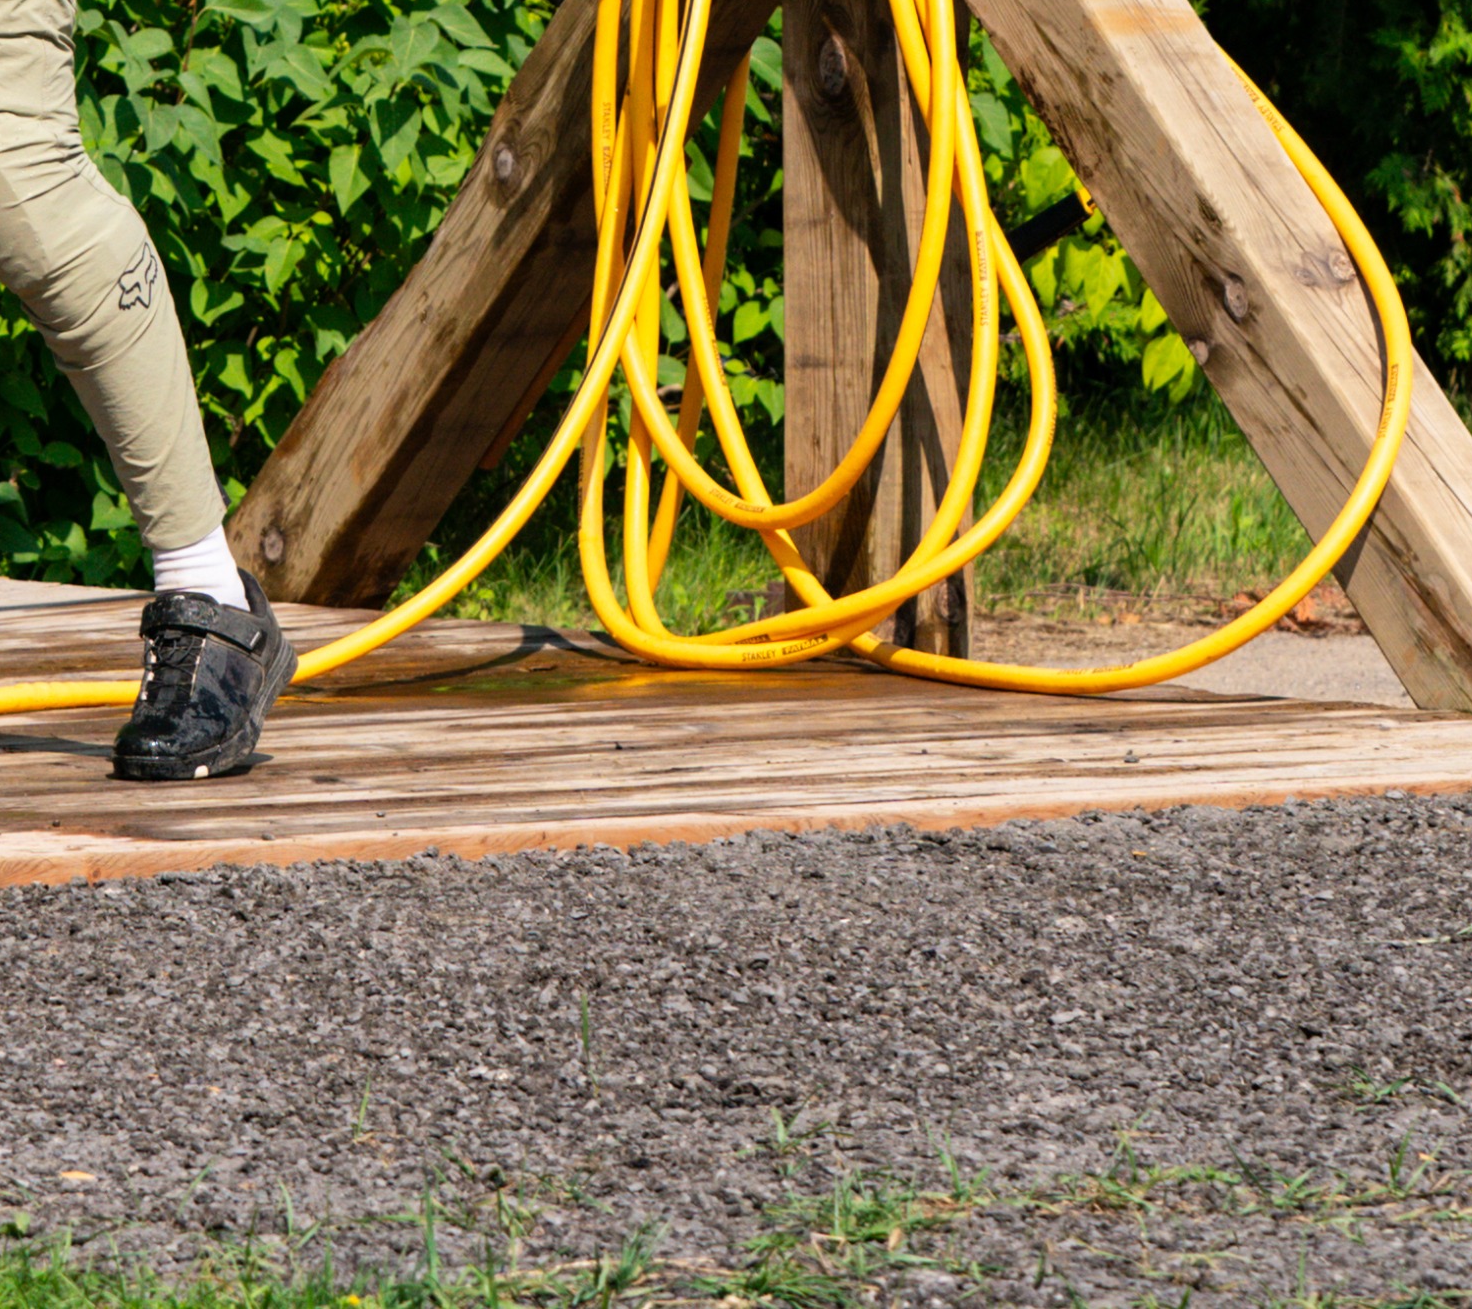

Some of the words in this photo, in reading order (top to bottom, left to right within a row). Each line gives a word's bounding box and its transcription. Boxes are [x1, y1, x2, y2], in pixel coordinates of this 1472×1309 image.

[602, 101, 612, 140] STANLEY
[979, 287, 989, 327] STANLEY
[741, 649, 776, 662] STANLEY
[782, 633, 829, 655] FATMAX
